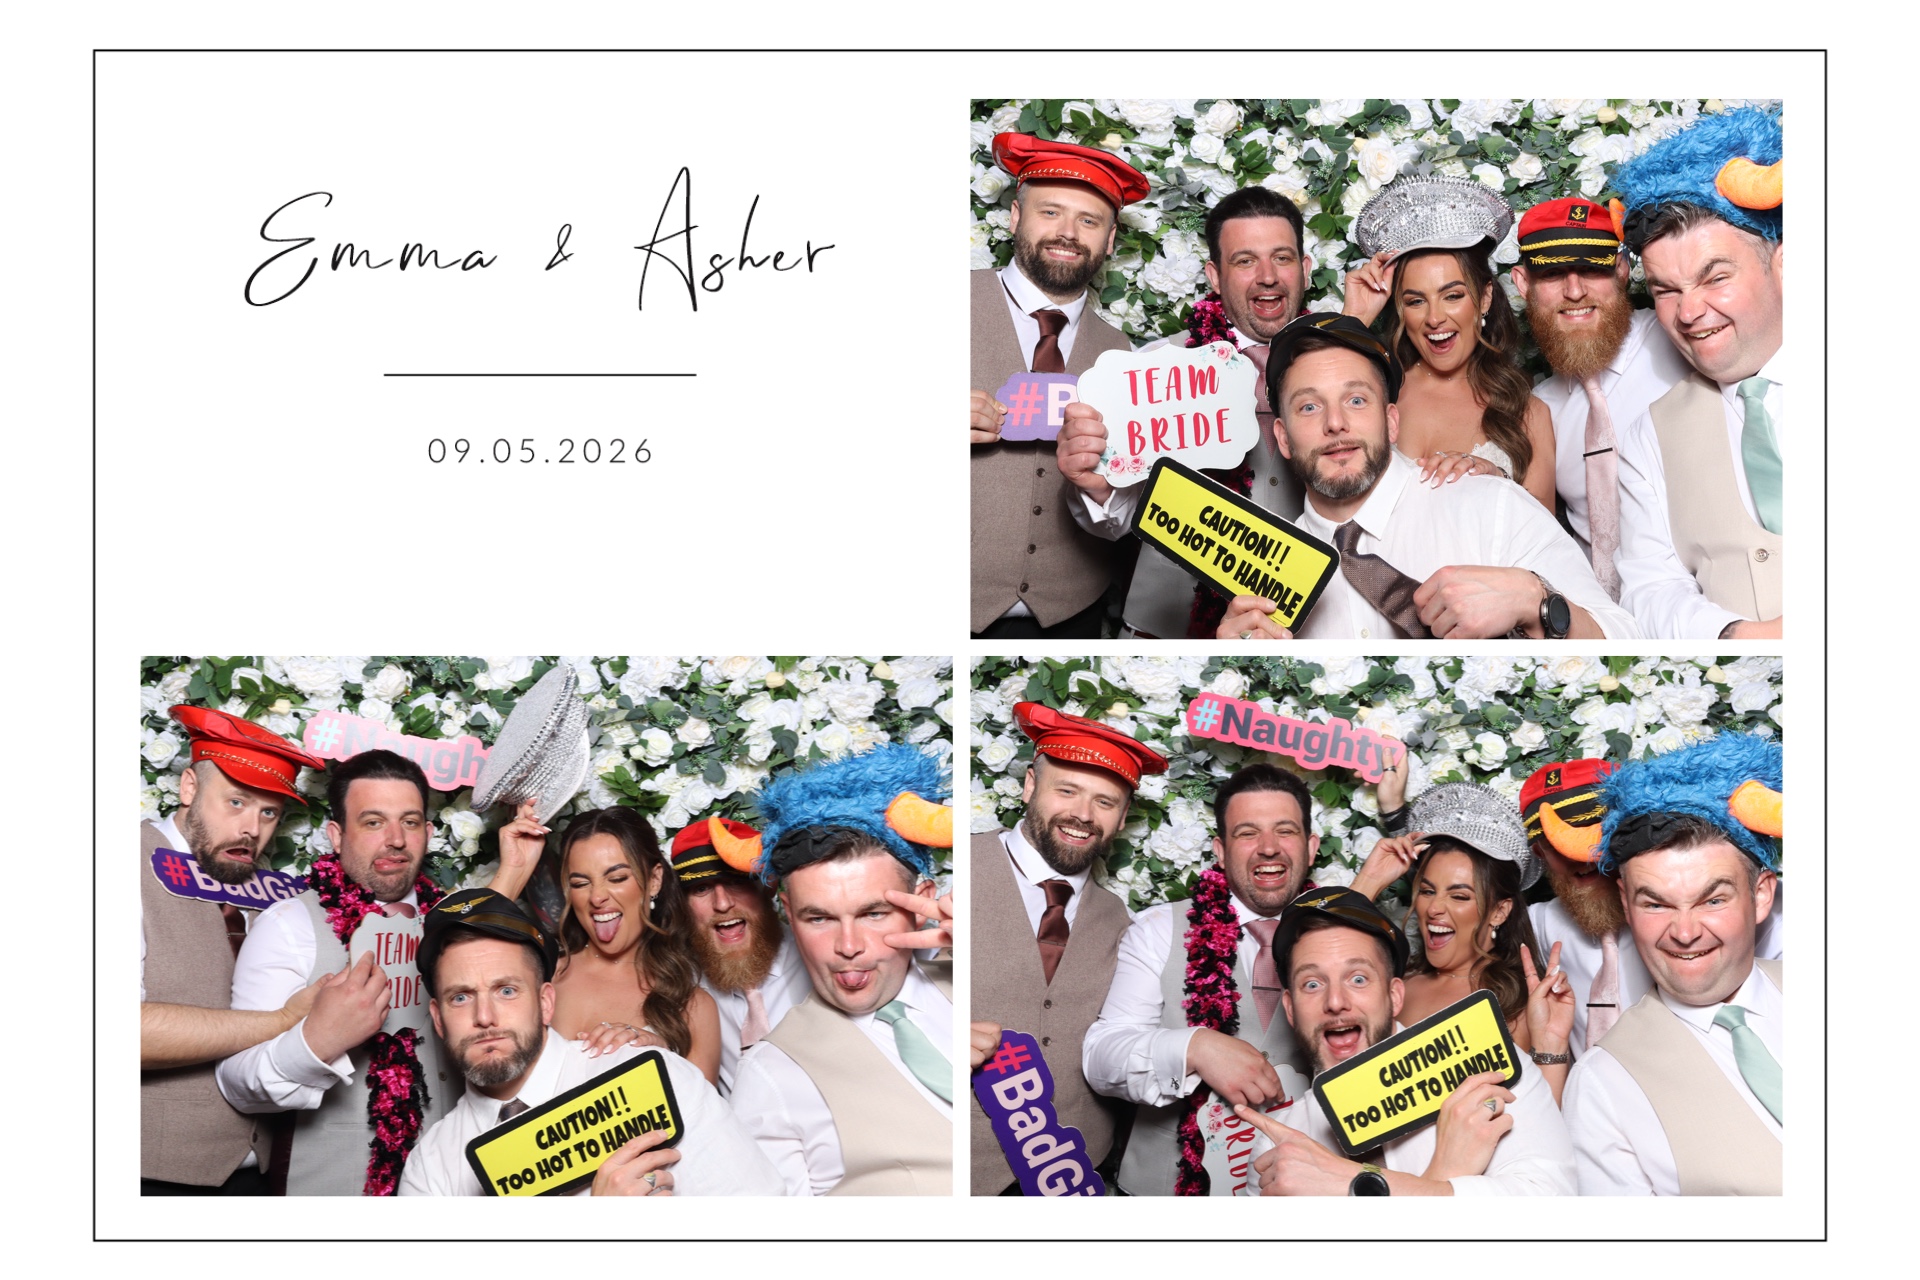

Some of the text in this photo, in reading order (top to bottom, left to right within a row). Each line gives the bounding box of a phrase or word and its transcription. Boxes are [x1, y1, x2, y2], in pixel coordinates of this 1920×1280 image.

[1565, 221, 1587, 229] CAPTAIN
[1123, 364, 1220, 407] TEAM
[1127, 408, 1232, 457] BRIDE
[1147, 502, 1304, 619] TOO HOT TO HANDLE
[1198, 505, 1291, 572] CAUTION!!
[1192, 698, 1398, 777] #Naughty
[374, 932, 420, 966] TEAM
[1343, 1043, 1510, 1133] TOO HOT TO HANDLE
[1379, 1024, 1469, 1088] CAUTION!!
[496, 1104, 672, 1195] TOO HOT TO HANDLE
[535, 1086, 631, 1151] CAUTION!!
